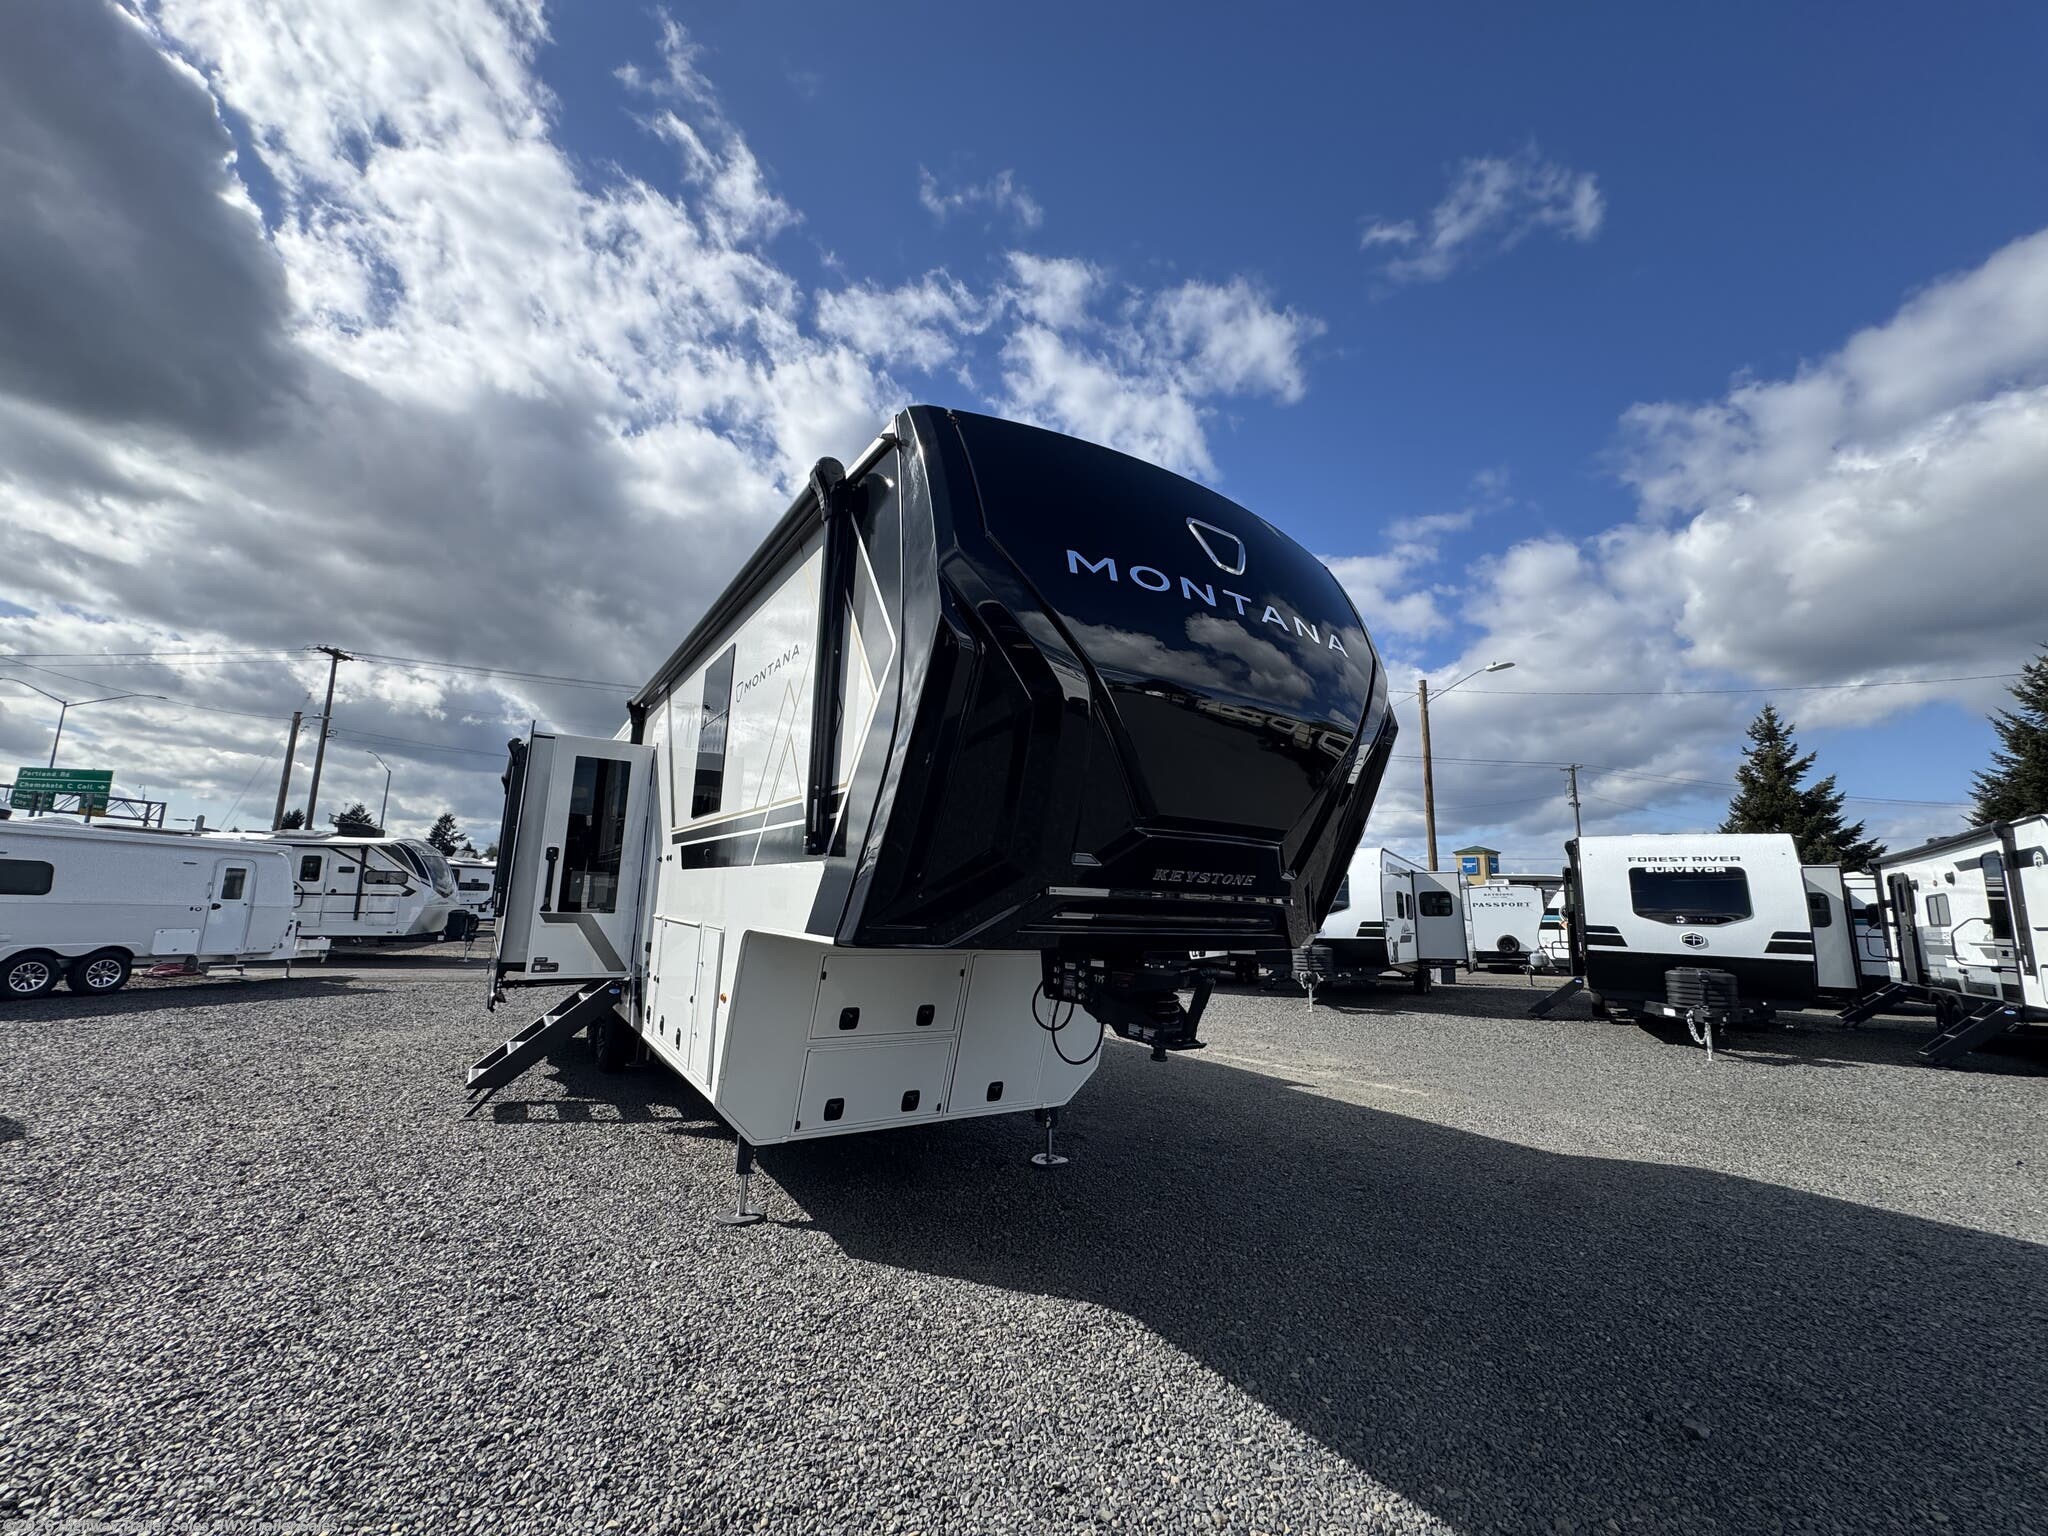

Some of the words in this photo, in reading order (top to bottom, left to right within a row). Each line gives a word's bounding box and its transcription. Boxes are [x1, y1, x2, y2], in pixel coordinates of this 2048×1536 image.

[1066, 549, 1349, 659] MONTANA
[744, 644, 800, 693] MONTANA
[1152, 869, 1256, 886] KEYSTONE
